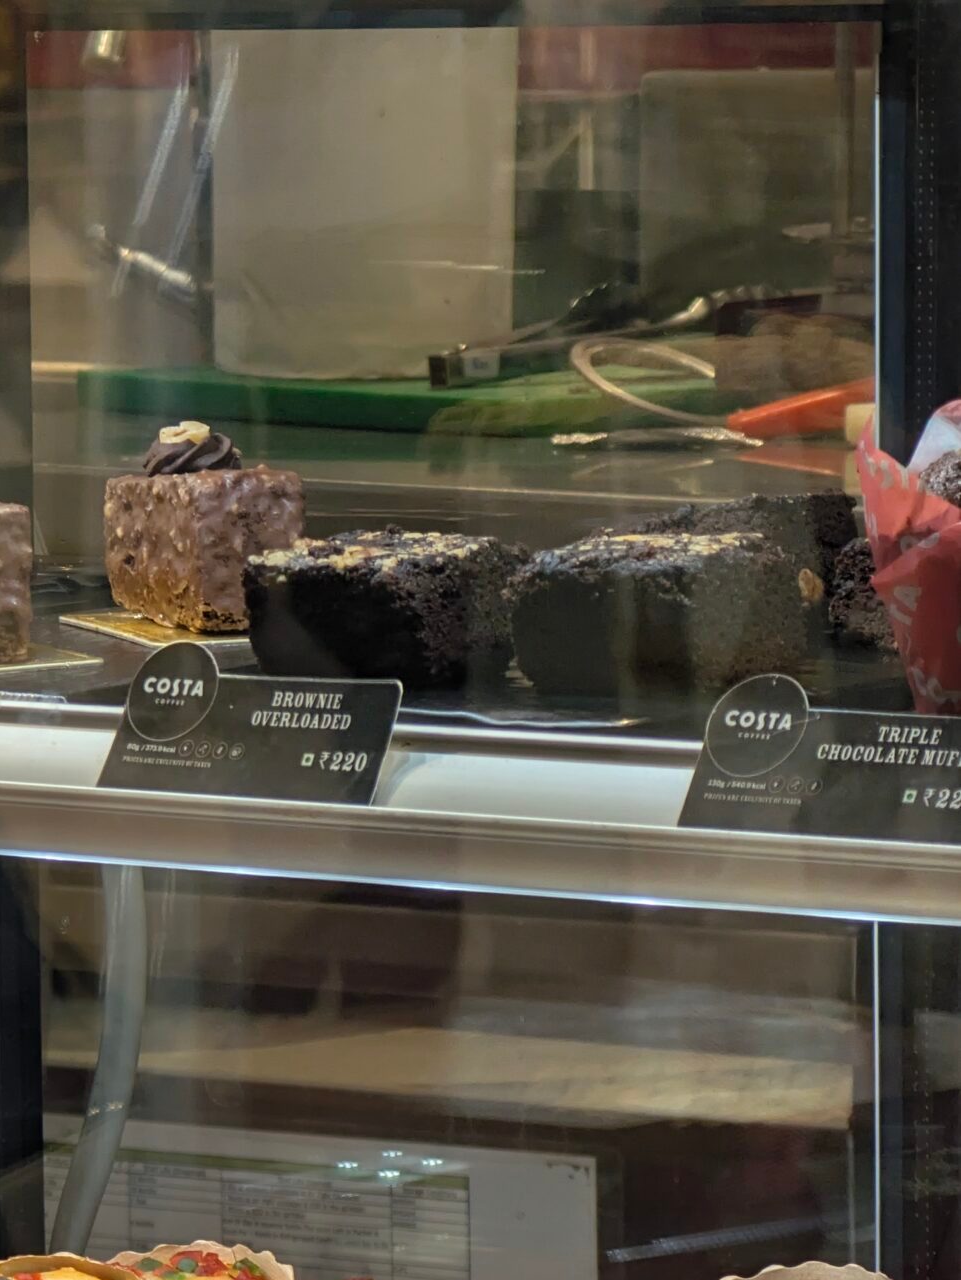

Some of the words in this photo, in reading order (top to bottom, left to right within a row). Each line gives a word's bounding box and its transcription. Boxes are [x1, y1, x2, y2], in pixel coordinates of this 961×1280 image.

[144, 676, 204, 697] COSTA
[155, 698, 185, 707] COFFEE
[272, 691, 343, 710] BROWNIE
[251, 711, 352, 731] OVERLOADED
[725, 710, 792, 730] COSTA
[738, 731, 771, 740] COFFEE
[878, 725, 943, 745] TRIPLE
[319, 751, 368, 773] ₹220
[817, 744, 919, 765] CHOCOLATE
[921, 749, 961, 767] MUF
